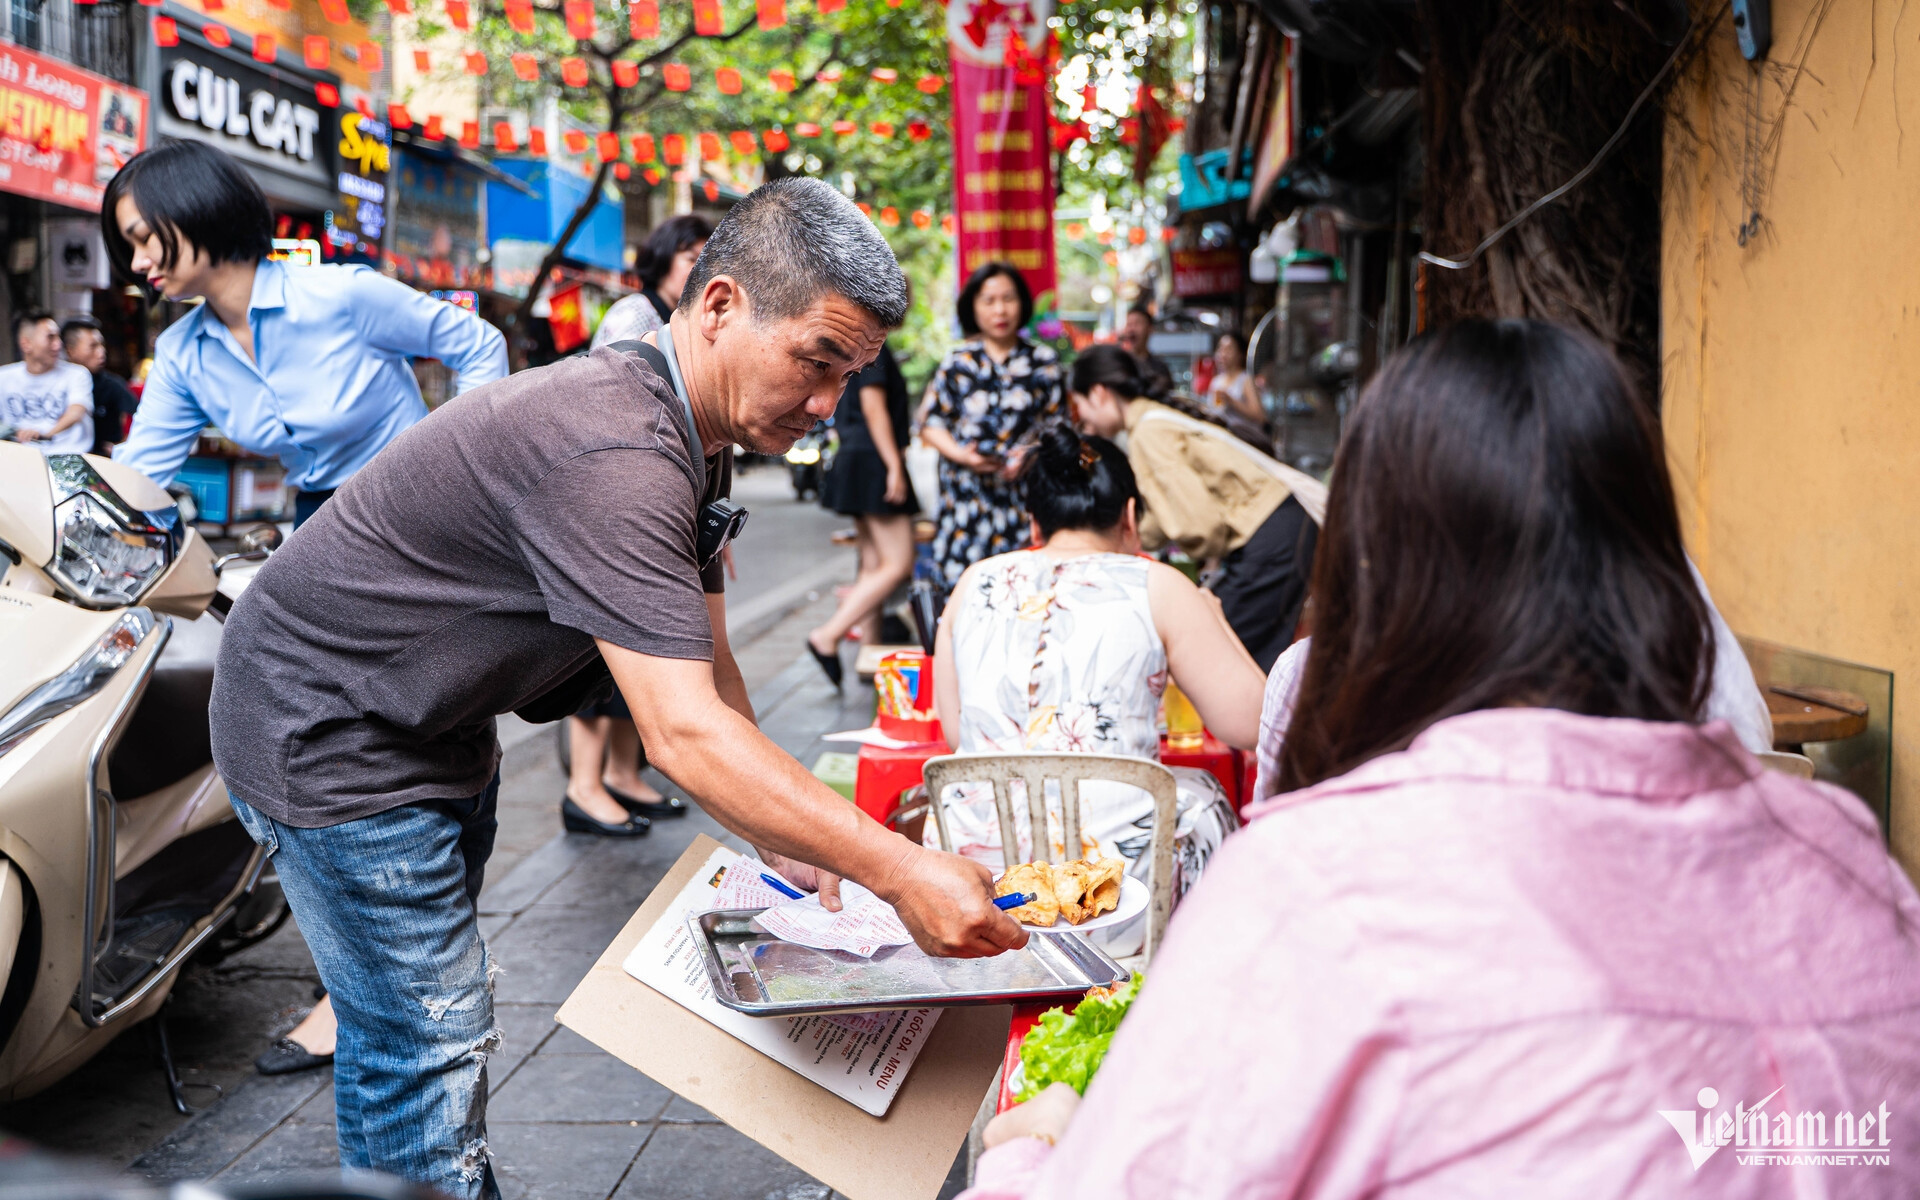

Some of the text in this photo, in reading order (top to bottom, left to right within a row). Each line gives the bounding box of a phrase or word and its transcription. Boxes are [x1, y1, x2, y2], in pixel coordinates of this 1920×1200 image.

[171, 59, 320, 161] CUL CAT
[904, 1014, 927, 1039] GỐC
[880, 1042, 889, 1053] can
[885, 1033, 895, 1044] and
[895, 1035, 912, 1053] ĐA
[874, 1056, 900, 1090] MENU
